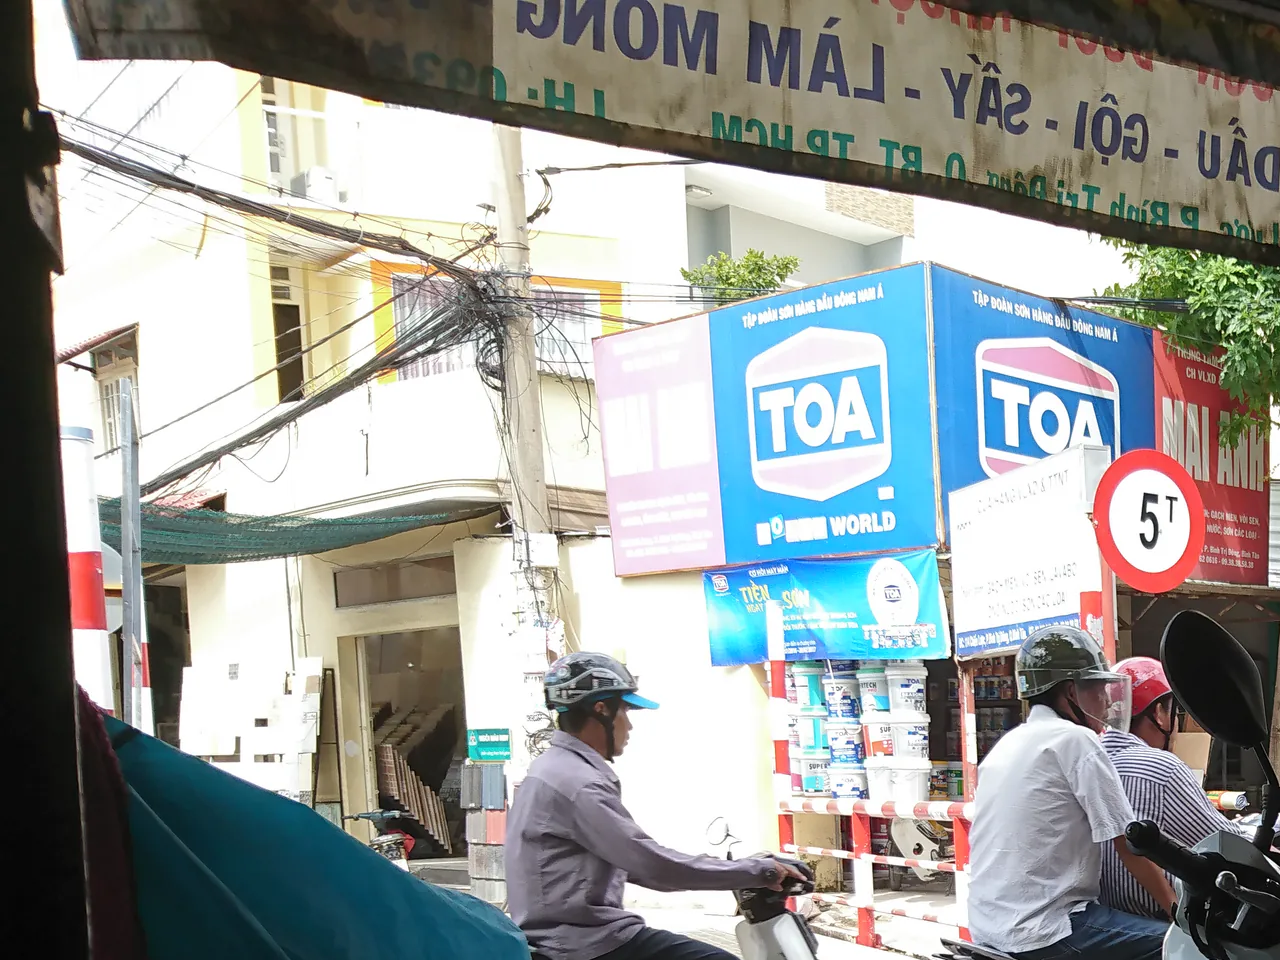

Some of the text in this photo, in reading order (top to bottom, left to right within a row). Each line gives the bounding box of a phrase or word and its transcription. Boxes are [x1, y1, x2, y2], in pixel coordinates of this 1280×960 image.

[1094, 324, 1111, 341] NAM
[1185, 366, 1196, 380] CH
[1197, 368, 1217, 386] VLXD
[758, 375, 877, 453] TOA
[990, 380, 1103, 456] TOA
[1161, 396, 1211, 482] MAI
[829, 510, 897, 537] WORLD
